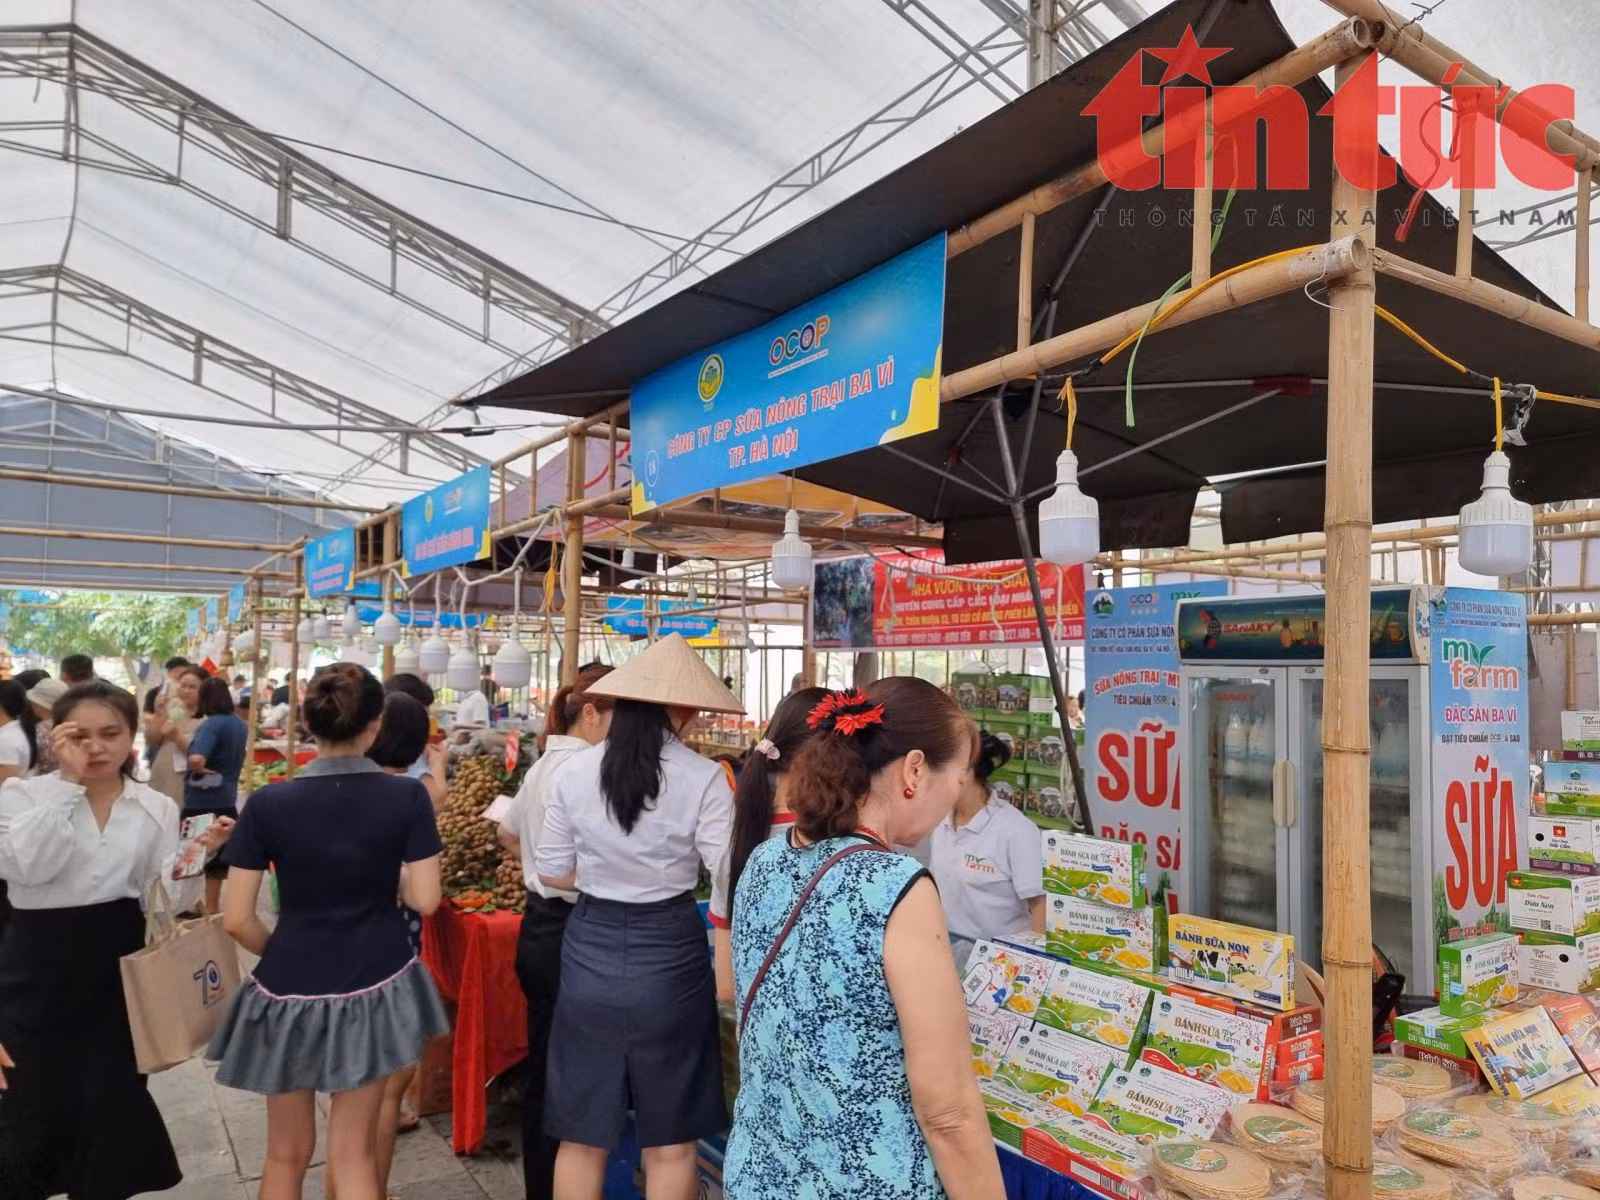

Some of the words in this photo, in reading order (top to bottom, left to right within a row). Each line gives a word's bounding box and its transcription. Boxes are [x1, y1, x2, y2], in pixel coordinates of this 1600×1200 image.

[770, 315, 830, 366] OCOP
[667, 431, 695, 459] CÔNG
[698, 425, 712, 448] TY
[714, 418, 732, 442] CP
[734, 407, 762, 436] SỮA
[766, 394, 807, 427] NÔNG
[811, 378, 846, 411] TRẠI
[849, 368, 873, 398] BA
[728, 445, 746, 469] TP.
[749, 434, 768, 464] HÀ
[772, 428, 799, 459] NỘI
[1109, 627, 1116, 638] TY
[1162, 624, 1175, 637] NÔN
[1222, 622, 1276, 634] SANAKY
[1443, 639, 1496, 664] my
[1113, 671, 1137, 687] NÔNG
[1139, 670, 1160, 687] TRẠI
[1451, 658, 1518, 689] farm
[1445, 704, 1466, 725] ĐẶC
[1468, 704, 1489, 722] SẢN
[1492, 708, 1504, 722] BA
[1507, 704, 1517, 722] VÌ
[1444, 755, 1520, 911] SỮA
[965, 861, 995, 873] farm
[1175, 930, 1203, 945] BÁNH
[1205, 935, 1225, 951] SỮA
[1228, 942, 1250, 955] NON
[1419, 1051, 1440, 1066] Bánh
